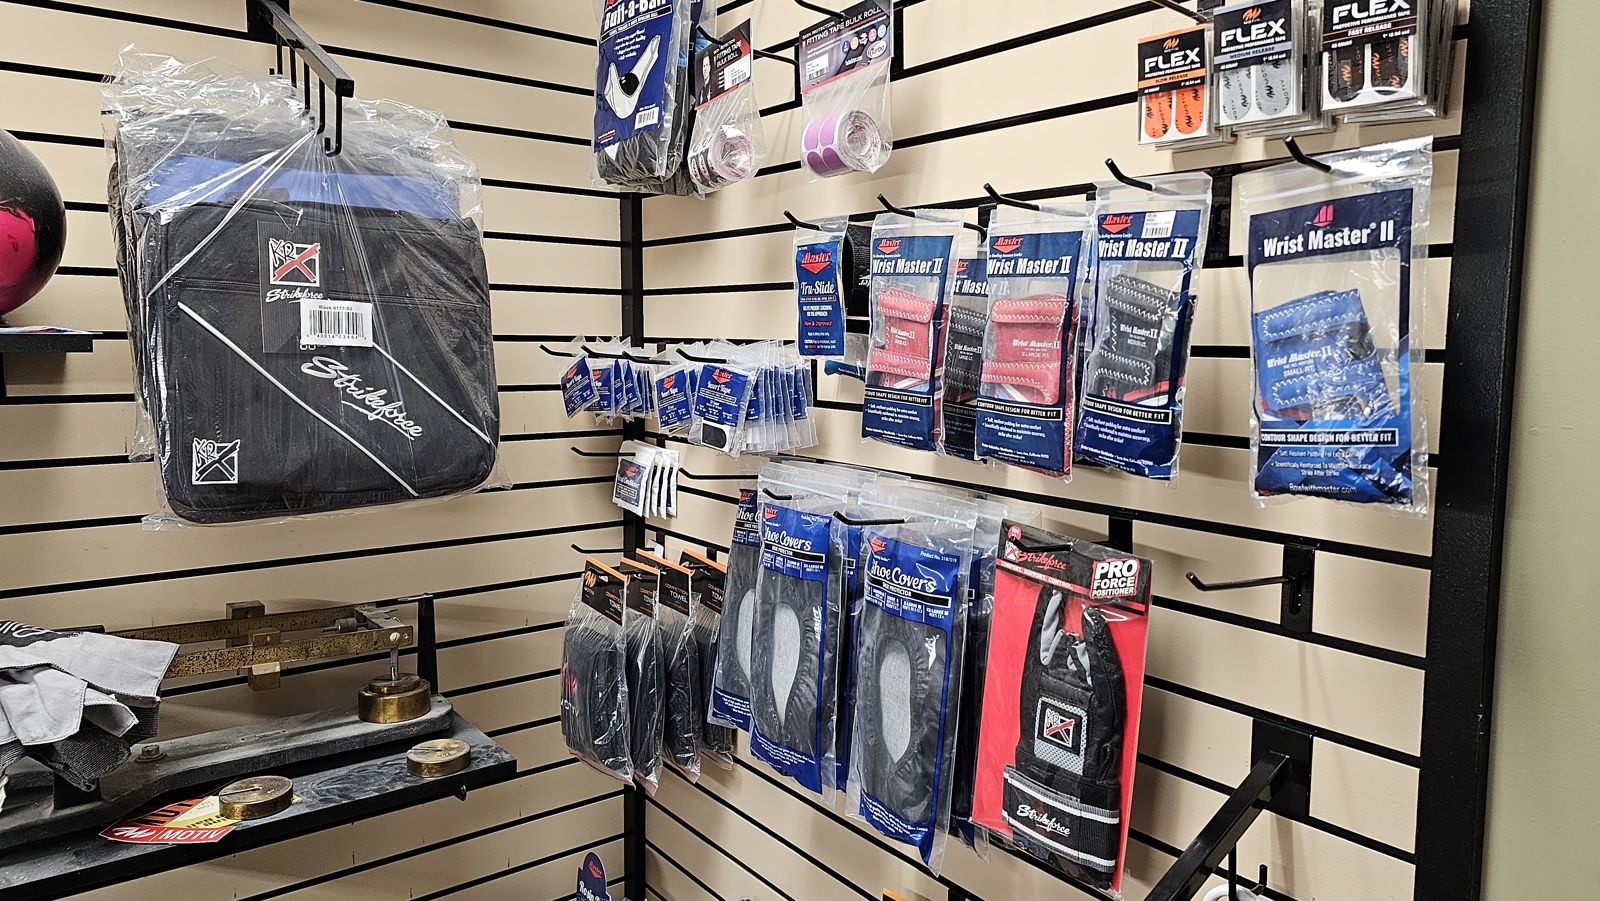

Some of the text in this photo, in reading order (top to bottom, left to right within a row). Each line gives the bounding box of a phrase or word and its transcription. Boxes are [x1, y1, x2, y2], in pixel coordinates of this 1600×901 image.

[1332, 0, 1411, 24] FLEX
[806, 6, 882, 46] FITTING TAPE BULK ROLL
[1221, 18, 1286, 48] FLEX
[1364, 22, 1392, 33] RELEASE
[1144, 47, 1200, 73] FLEX
[1230, 46, 1275, 59] MEDIUM RELEASE
[1168, 73, 1188, 81] RELEASE
[1103, 214, 1133, 225] Master
[995, 236, 1024, 246] Master
[1263, 236, 1304, 257] Wrist
[1379, 220, 1395, 242] II
[1125, 239, 1170, 258] Master
[1171, 238, 1189, 258] II
[801, 251, 832, 264] Master
[896, 258, 933, 274] Master
[932, 257, 944, 273] II
[1016, 257, 1059, 274] Master
[1059, 255, 1072, 274] II
[265, 287, 324, 303] Strikeforce
[800, 280, 836, 296] Tru-Slide
[1267, 355, 1288, 368] Wrist
[1289, 350, 1321, 363] Master
[300, 355, 423, 440] Strikeforce
[977, 401, 994, 409] CONTOUR
[1005, 406, 1020, 414] DESIGN
[1094, 402, 1107, 410] SHAPE
[1107, 405, 1122, 413] DESIGN
[1132, 410, 1152, 419] BETTER
[1261, 433, 1286, 442] CONTOUR
[1287, 433, 1308, 442] SHAPE
[1309, 433, 1334, 443] DESIGN
[1335, 433, 1350, 443] FOR
[1380, 432, 1392, 442] FIT
[779, 530, 812, 551] Covers
[920, 550, 934, 559] Product
[1016, 550, 1068, 572] Strikeforce
[1094, 559, 1139, 580] PRO
[891, 567, 937, 593] Covers
[1093, 577, 1135, 590] FORCE
[665, 582, 688, 596] COMPETITION
[669, 590, 688, 604] TOWEL
[1092, 587, 1135, 597] POSITIONER
[1016, 804, 1071, 838] Strikeforce
[157, 829, 225, 840] MOTIV
